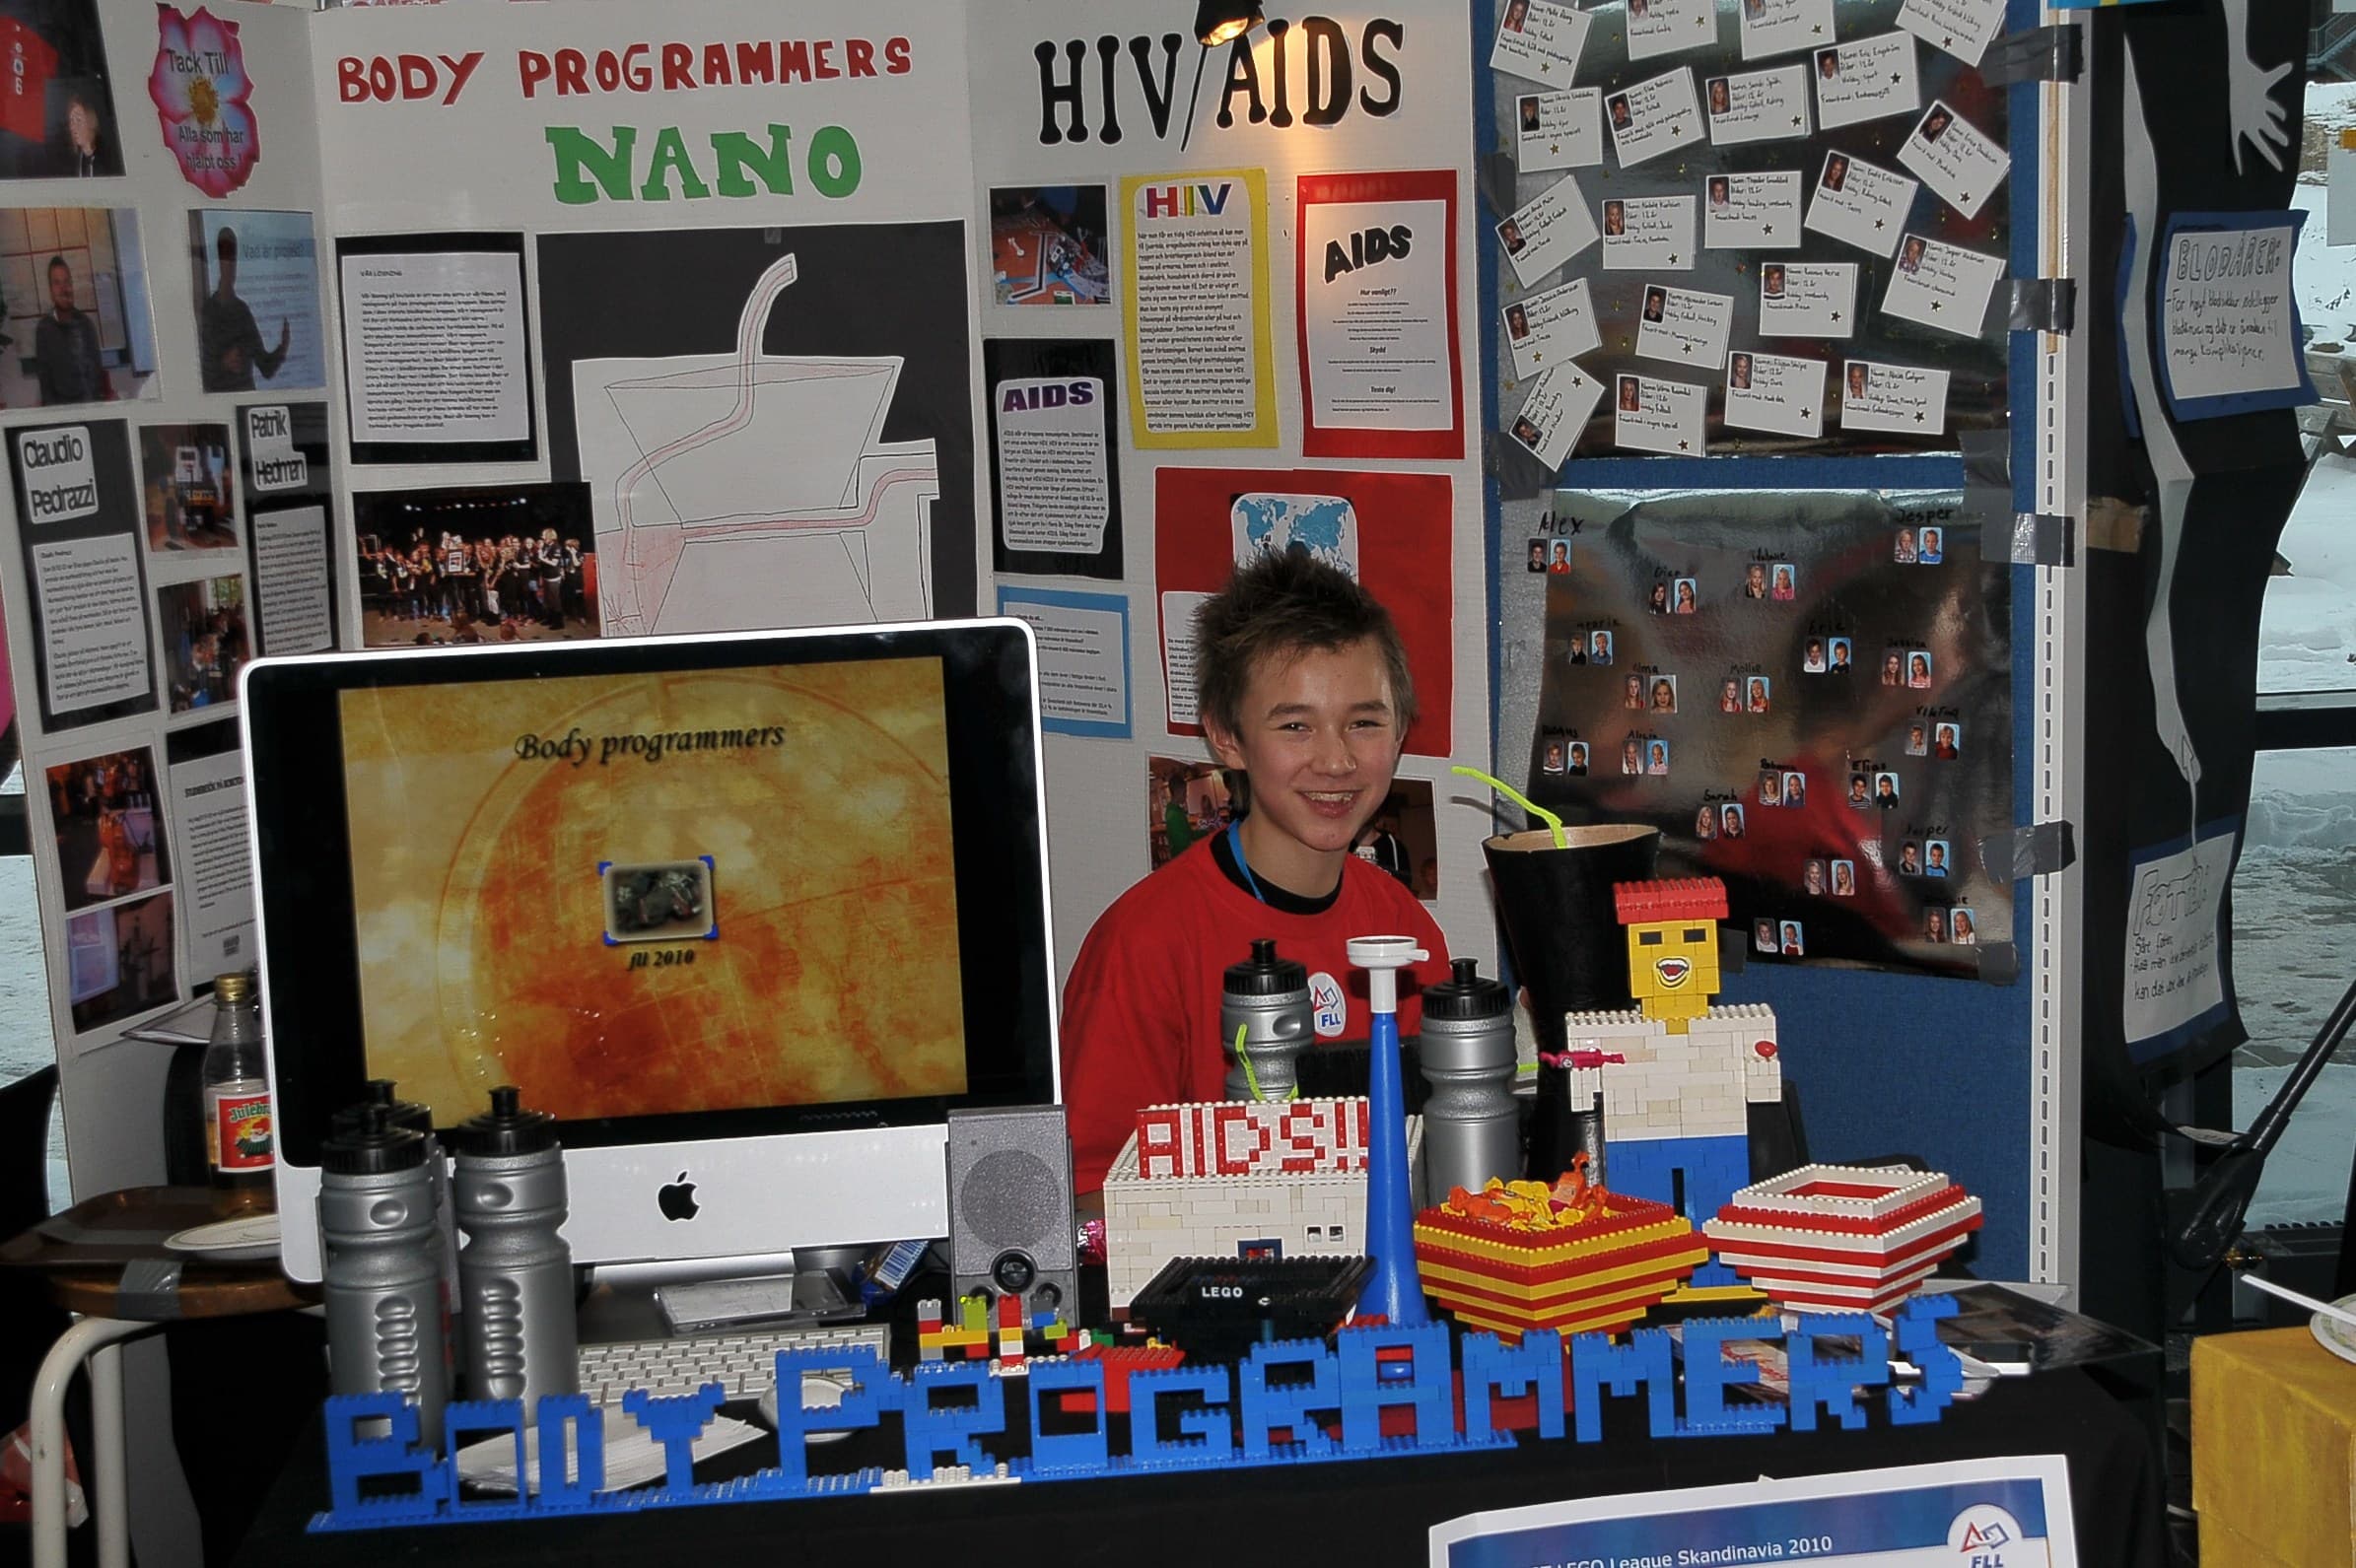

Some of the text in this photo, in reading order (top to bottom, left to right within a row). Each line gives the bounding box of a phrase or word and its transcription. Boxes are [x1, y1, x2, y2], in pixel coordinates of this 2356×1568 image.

[166, 48, 230, 75] Tack Till
[337, 36, 913, 105] BODY PROGRAMMERS
[178, 126, 244, 144] Alla som har
[544, 123, 863, 204] NANO
[1145, 183, 1232, 219] HIV
[1325, 225, 1413, 284] AIDS
[1003, 381, 1093, 412] AIDS
[250, 410, 289, 439] Patrik
[24, 434, 84, 469] Claudio
[254, 457, 307, 486] Hedman
[32, 478, 97, 517] Pedrazzi
[1538, 511, 1585, 536] Alex
[1898, 508, 1954, 523] Jesper
[516, 725, 786, 767] Body programmers
[1703, 787, 1738, 802] Sarah
[654, 949, 695, 967] 2010
[1320, 1013, 1342, 1027] FLL
[1137, 1101, 1369, 1180] AIDS!!
[1202, 1285, 1243, 1299] LEGO
[324, 1293, 1965, 1515] BODY PROGRAMMERS
[1678, 1541, 1783, 1567] Skandinavia
[1788, 1535, 1833, 1554] 2010
